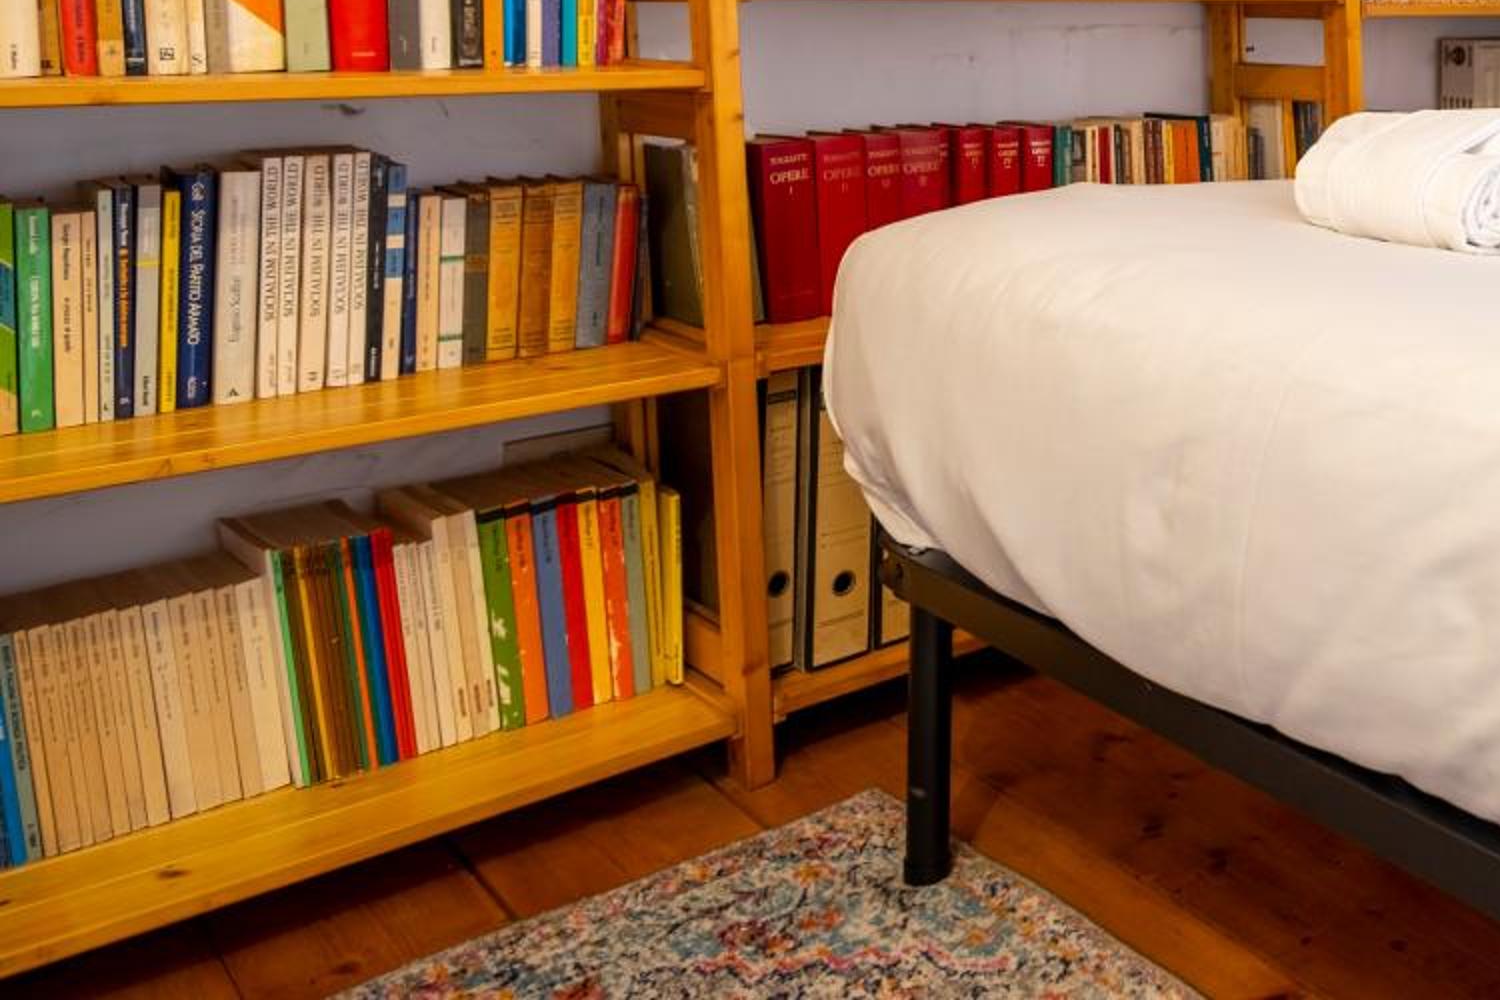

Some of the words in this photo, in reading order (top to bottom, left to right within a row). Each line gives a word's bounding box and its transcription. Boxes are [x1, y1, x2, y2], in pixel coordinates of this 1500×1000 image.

[264, 166, 278, 211] WORLD
[284, 162, 299, 207] WORLD
[311, 165, 326, 209] WORLD
[336, 162, 349, 205] WORLD
[357, 159, 370, 202] WORLD
[769, 168, 810, 185] OPERE
[190, 209, 206, 243] STORIA
[264, 214, 278, 237] THE
[284, 211, 297, 234] THE
[311, 213, 324, 235] THE
[336, 211, 349, 232] THE
[356, 208, 369, 228] THE
[189, 244, 204, 262] DEL
[264, 240, 278, 256] IN
[283, 237, 296, 252] IN
[310, 237, 323, 252] IN
[335, 235, 348, 250] IN
[354, 233, 367, 246] IN
[188, 262, 205, 301] PARTITO
[264, 258, 277, 322] SOCIALISM
[282, 254, 296, 318] SOCIALISM
[308, 255, 322, 318] SOCIALISM
[334, 253, 347, 315] SOCIALISM
[353, 250, 366, 311] SOCIALISM
[187, 301, 202, 345] ARMATO
